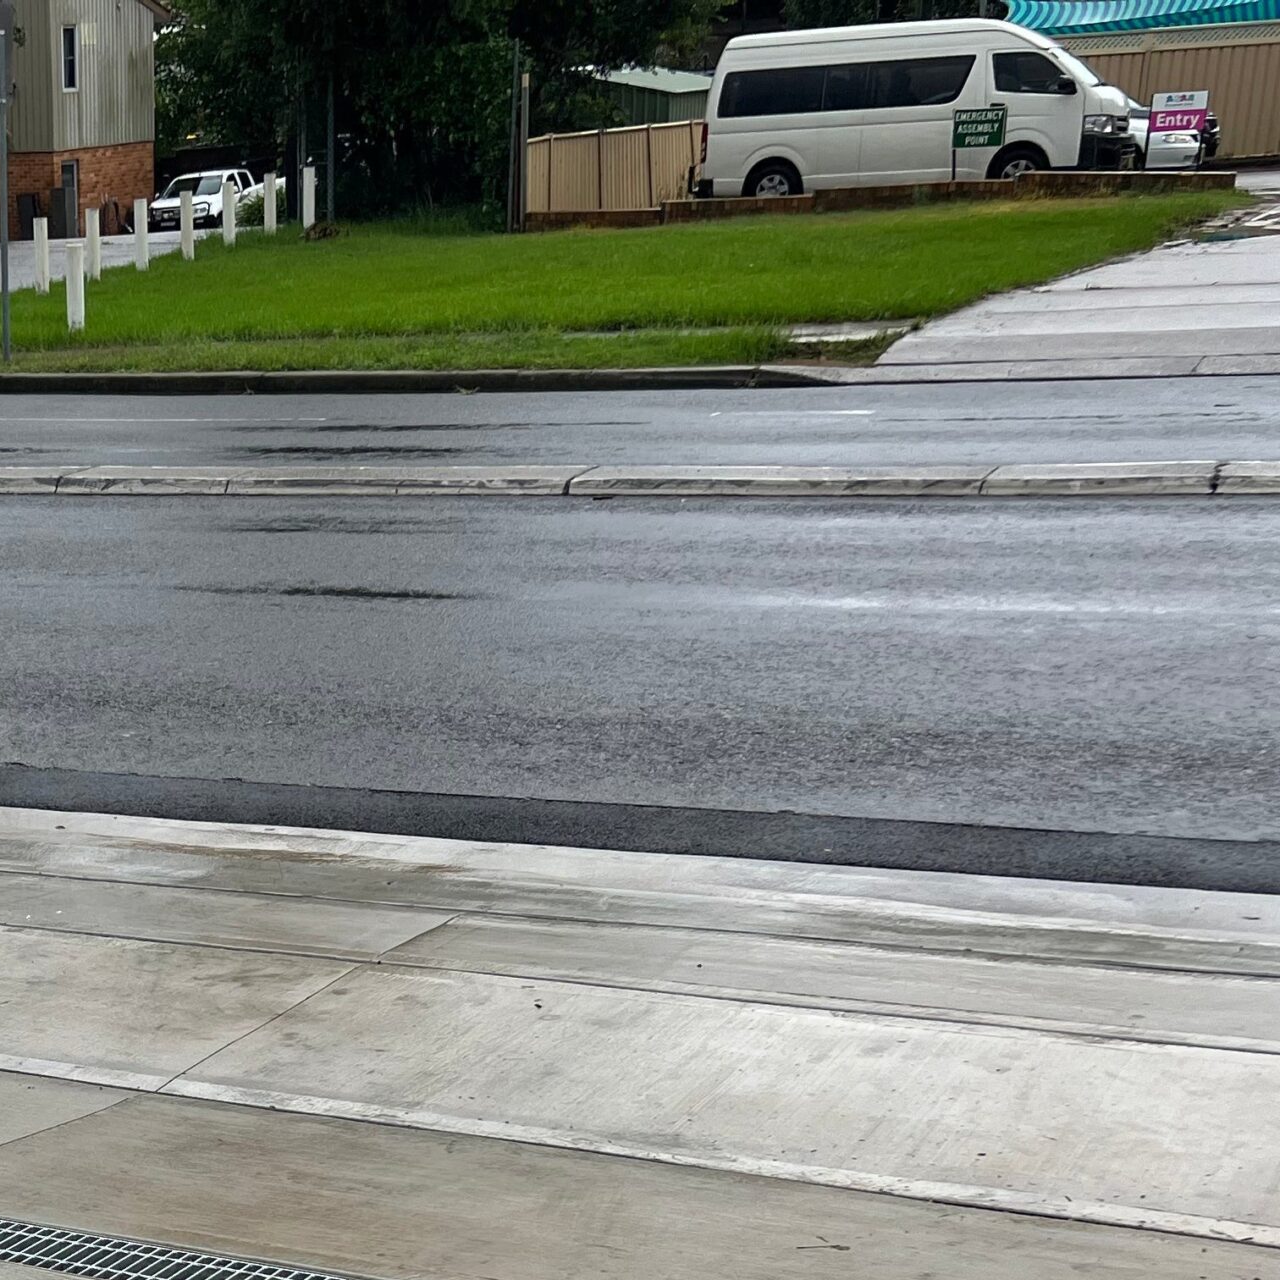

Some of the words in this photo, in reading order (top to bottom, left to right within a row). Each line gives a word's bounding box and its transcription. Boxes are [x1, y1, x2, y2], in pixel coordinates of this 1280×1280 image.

[955, 110, 1004, 121] EMERGENCY
[1155, 113, 1200, 128] Entry
[956, 123, 999, 134] ASSEMBLY
[964, 135, 989, 146] POINT
